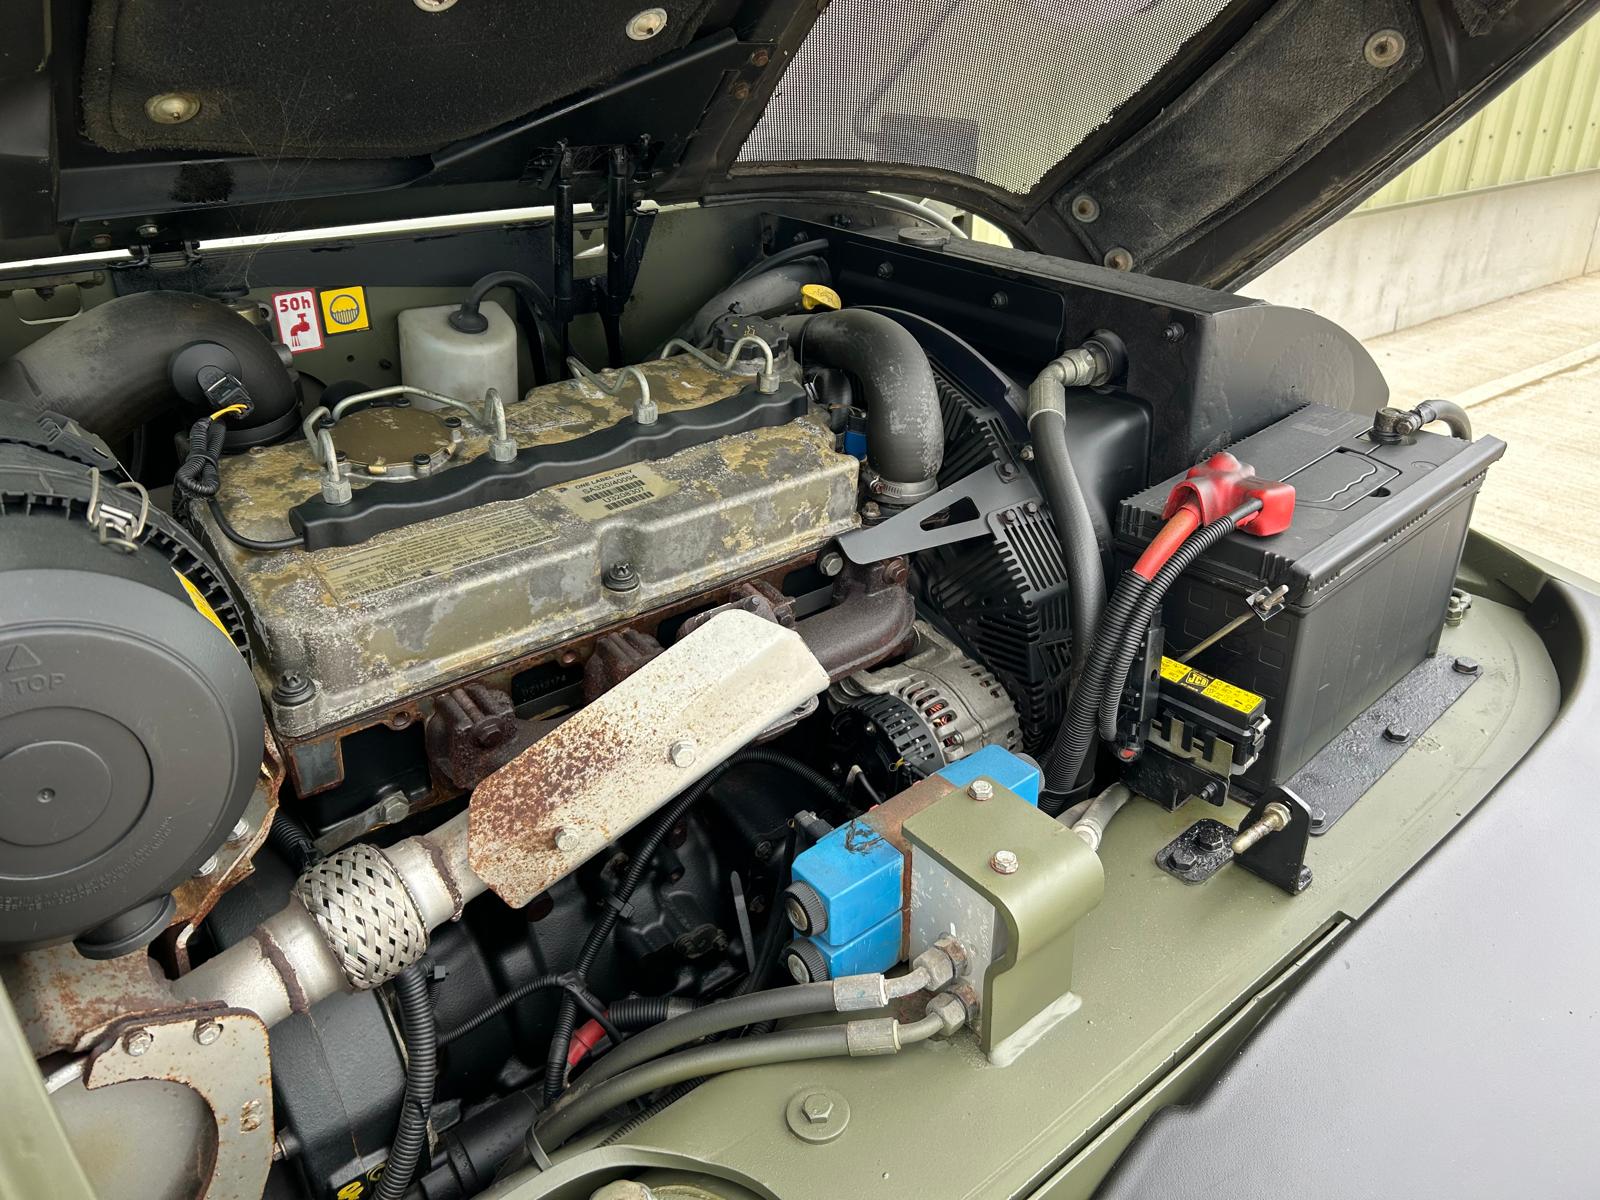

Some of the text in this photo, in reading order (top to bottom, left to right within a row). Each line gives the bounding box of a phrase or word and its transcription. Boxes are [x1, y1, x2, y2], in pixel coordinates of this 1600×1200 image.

[280, 296, 311, 312] 50h
[591, 475, 613, 485] LABEL
[613, 469, 632, 478] ONLY
[9, 672, 66, 694] TOP
[1187, 671, 1208, 687] JCB
